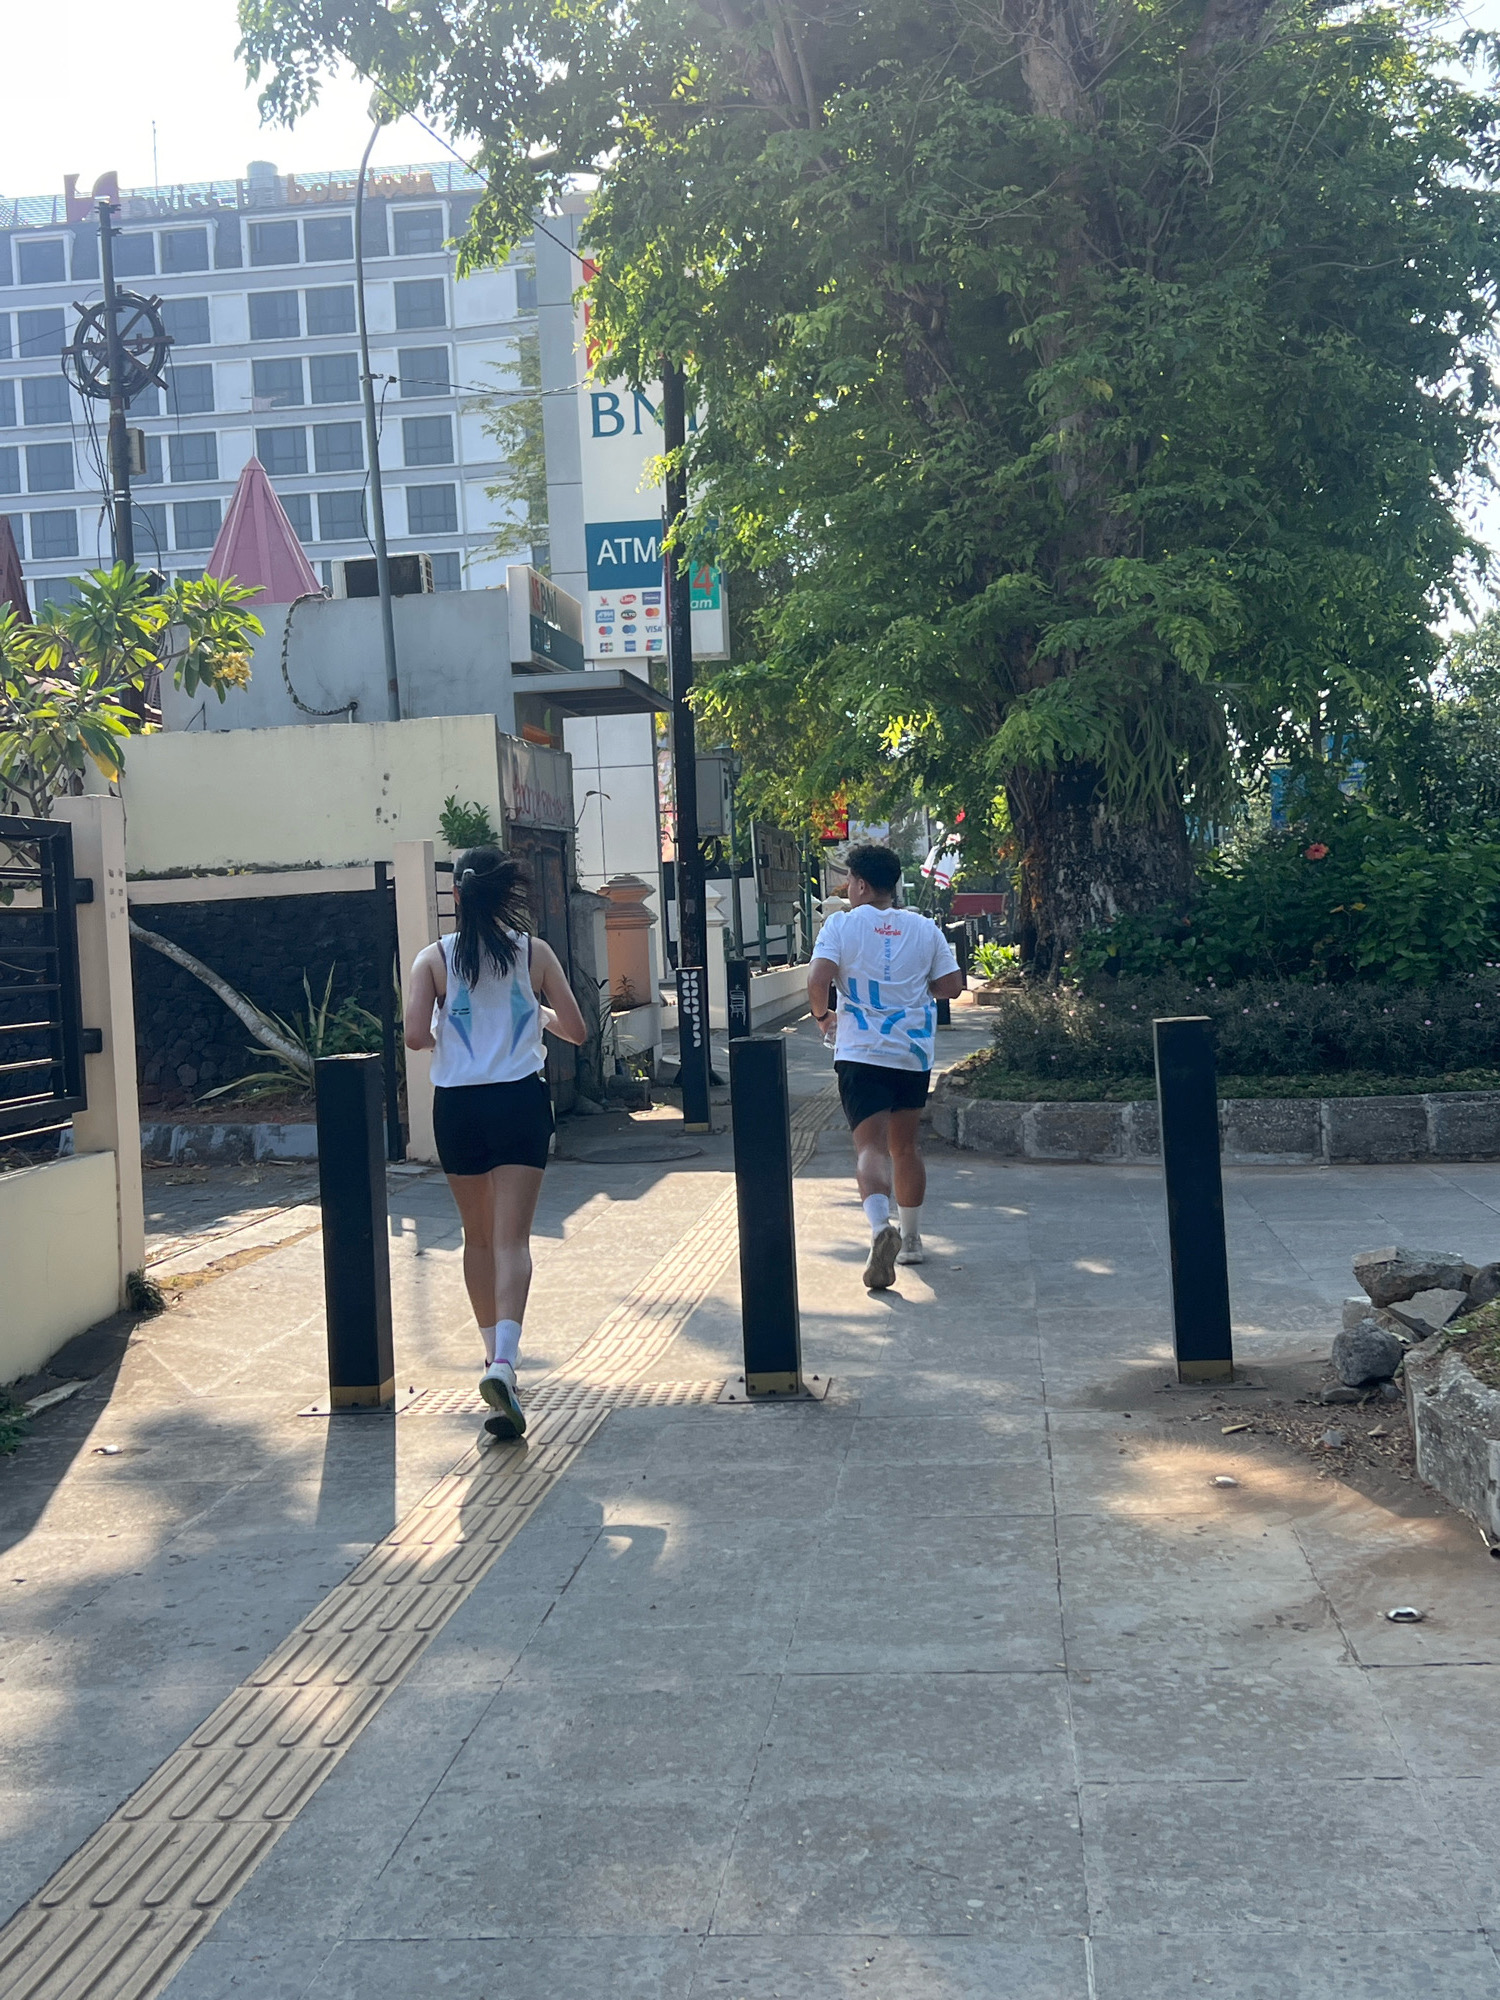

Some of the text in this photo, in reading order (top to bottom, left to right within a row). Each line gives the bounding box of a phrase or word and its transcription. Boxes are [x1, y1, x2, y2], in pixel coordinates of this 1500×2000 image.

[597, 536, 657, 566] ATM
[690, 599, 712, 609] am
[645, 625, 663, 633] VISA
[883, 922, 892, 930] Le
